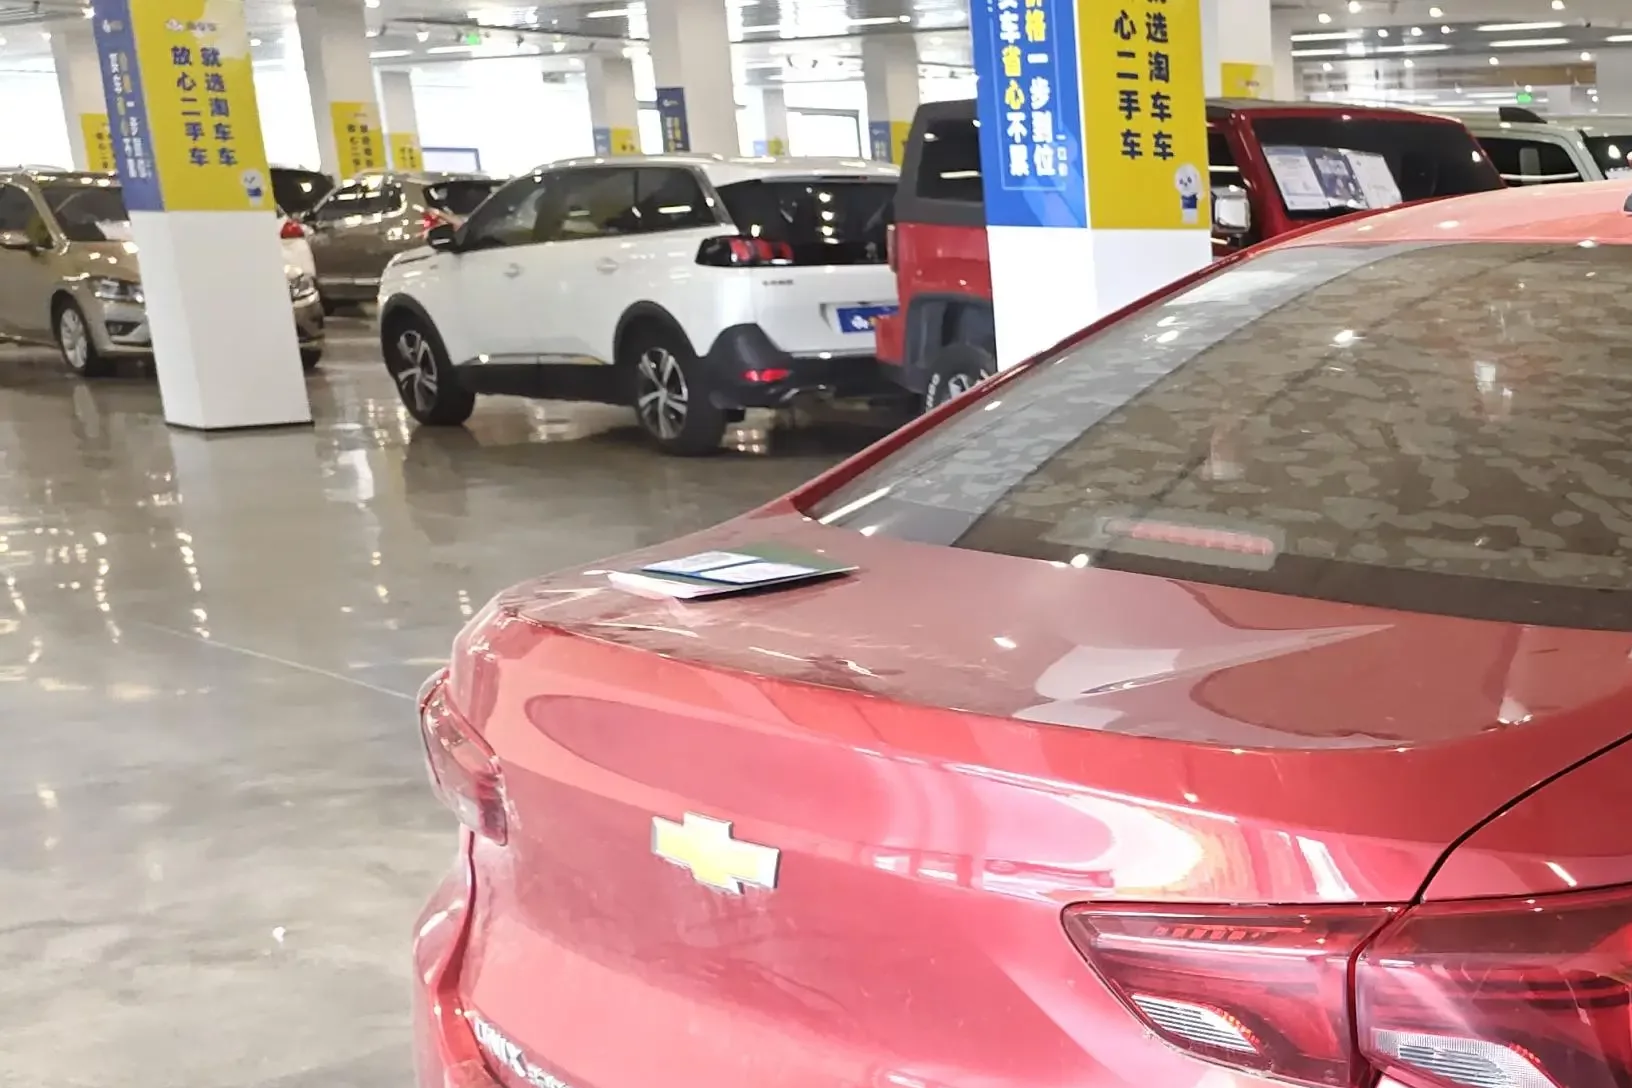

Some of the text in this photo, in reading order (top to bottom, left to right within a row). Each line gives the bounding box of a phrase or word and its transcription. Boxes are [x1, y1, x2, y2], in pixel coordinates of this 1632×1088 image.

[171, 45, 210, 167] 放心二手车
[200, 46, 238, 167] 就选淘车车
[1025, 0, 1056, 176] 格一步到位
[1145, 0, 1175, 161] 选淘车车
